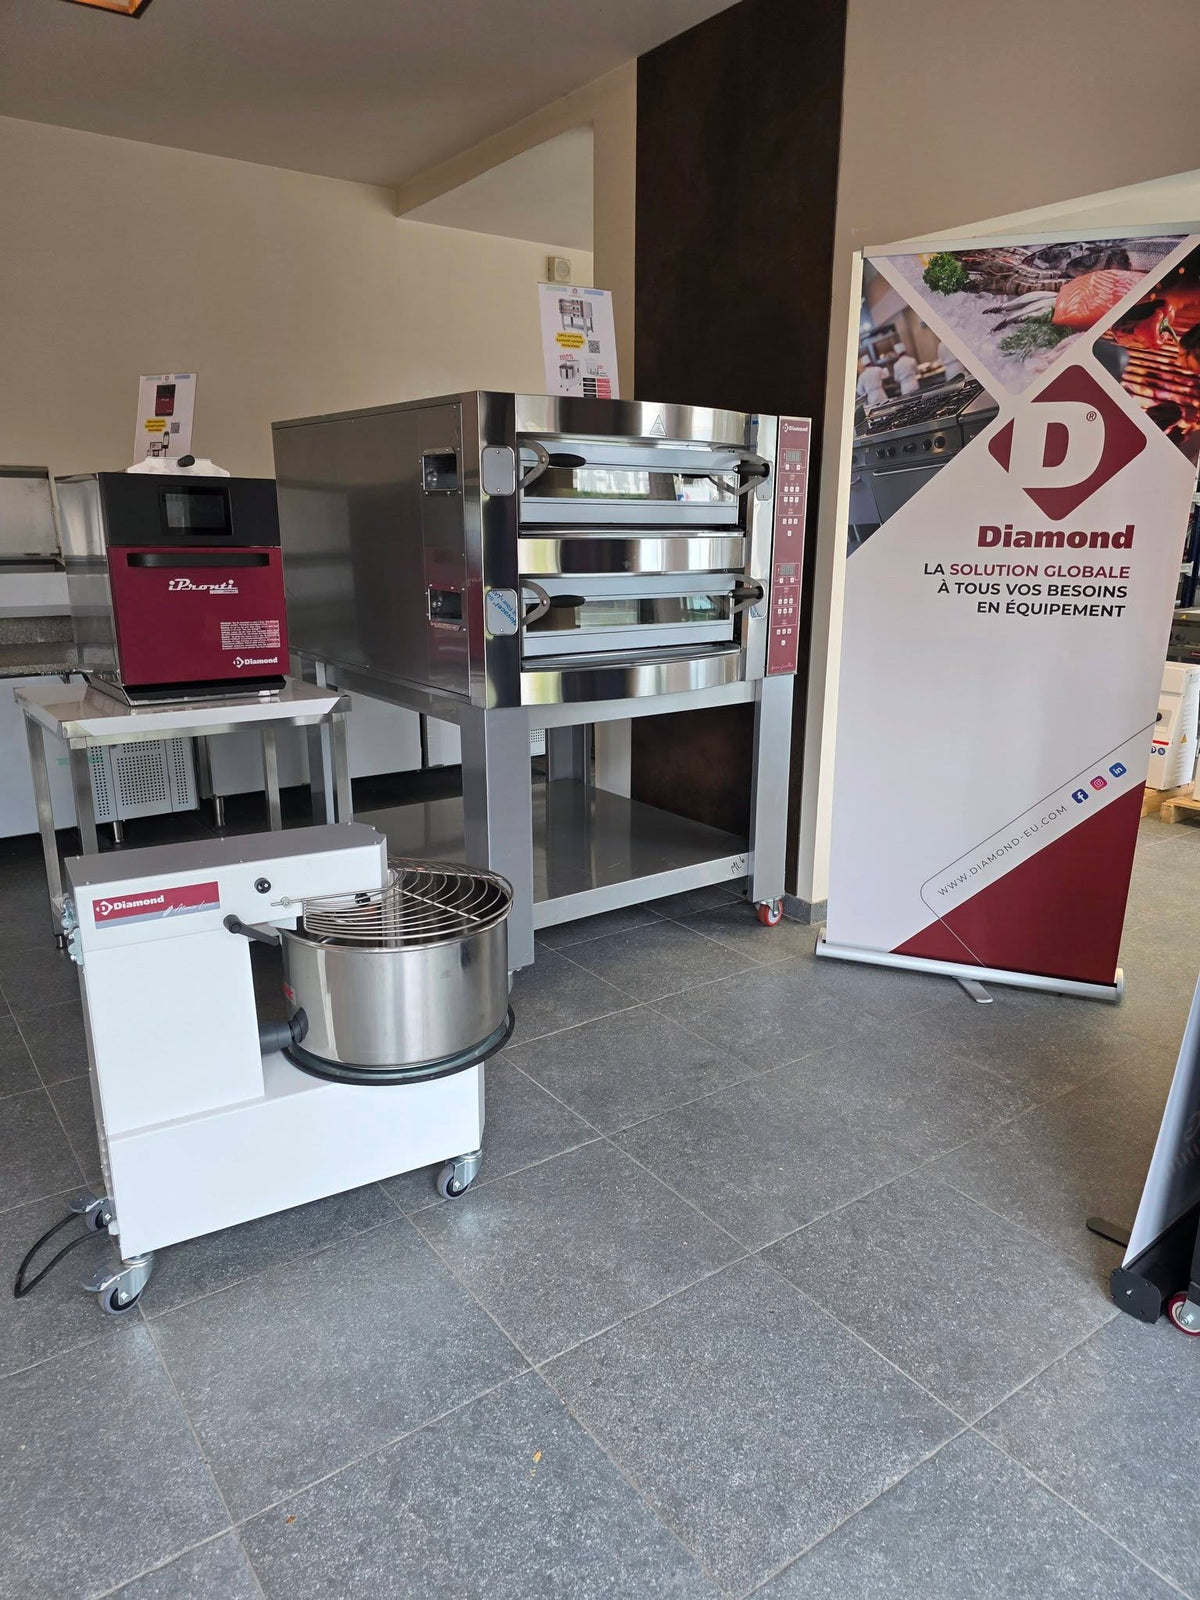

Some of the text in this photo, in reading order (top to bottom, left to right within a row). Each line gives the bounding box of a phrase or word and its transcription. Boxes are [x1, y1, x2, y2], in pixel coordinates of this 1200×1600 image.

[978, 524, 1135, 549] Diamond
[924, 563, 1131, 579] LA SOLUTION GLOBALE
[168, 578, 238, 591] iPronti
[937, 579, 1128, 598] À TOUS VOS BESOINS
[977, 599, 1126, 617] EN ÉQUIPEMENT
[244, 656, 278, 665] Diamond
[937, 805, 1067, 896] WWW.DIAMOND-EU.COM
[113, 894, 165, 911] Diamond
